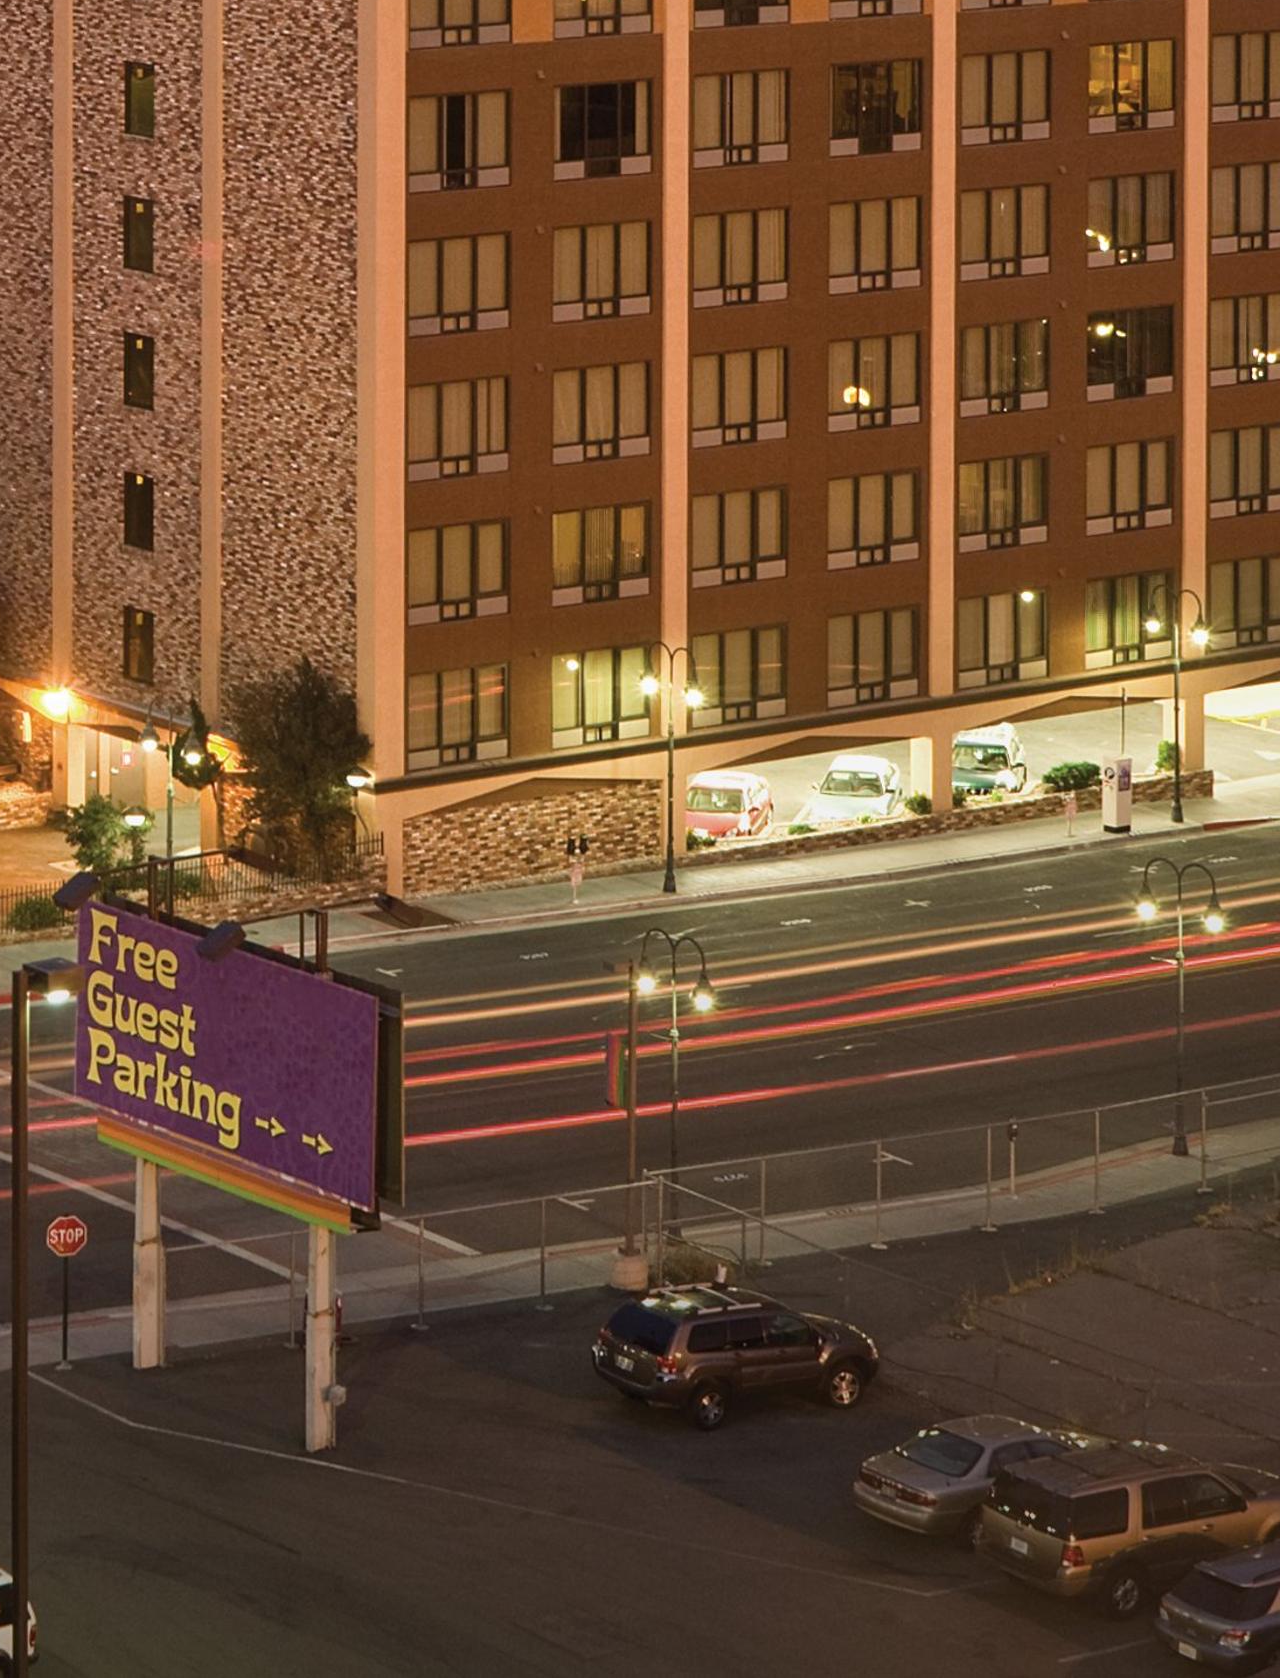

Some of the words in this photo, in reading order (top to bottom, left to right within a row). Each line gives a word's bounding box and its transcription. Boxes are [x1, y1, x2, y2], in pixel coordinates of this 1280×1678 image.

[87, 908, 179, 990] Free
[87, 970, 197, 1057] Guest
[86, 1025, 242, 1150] Parking
[50, 1227, 84, 1244] STOP
